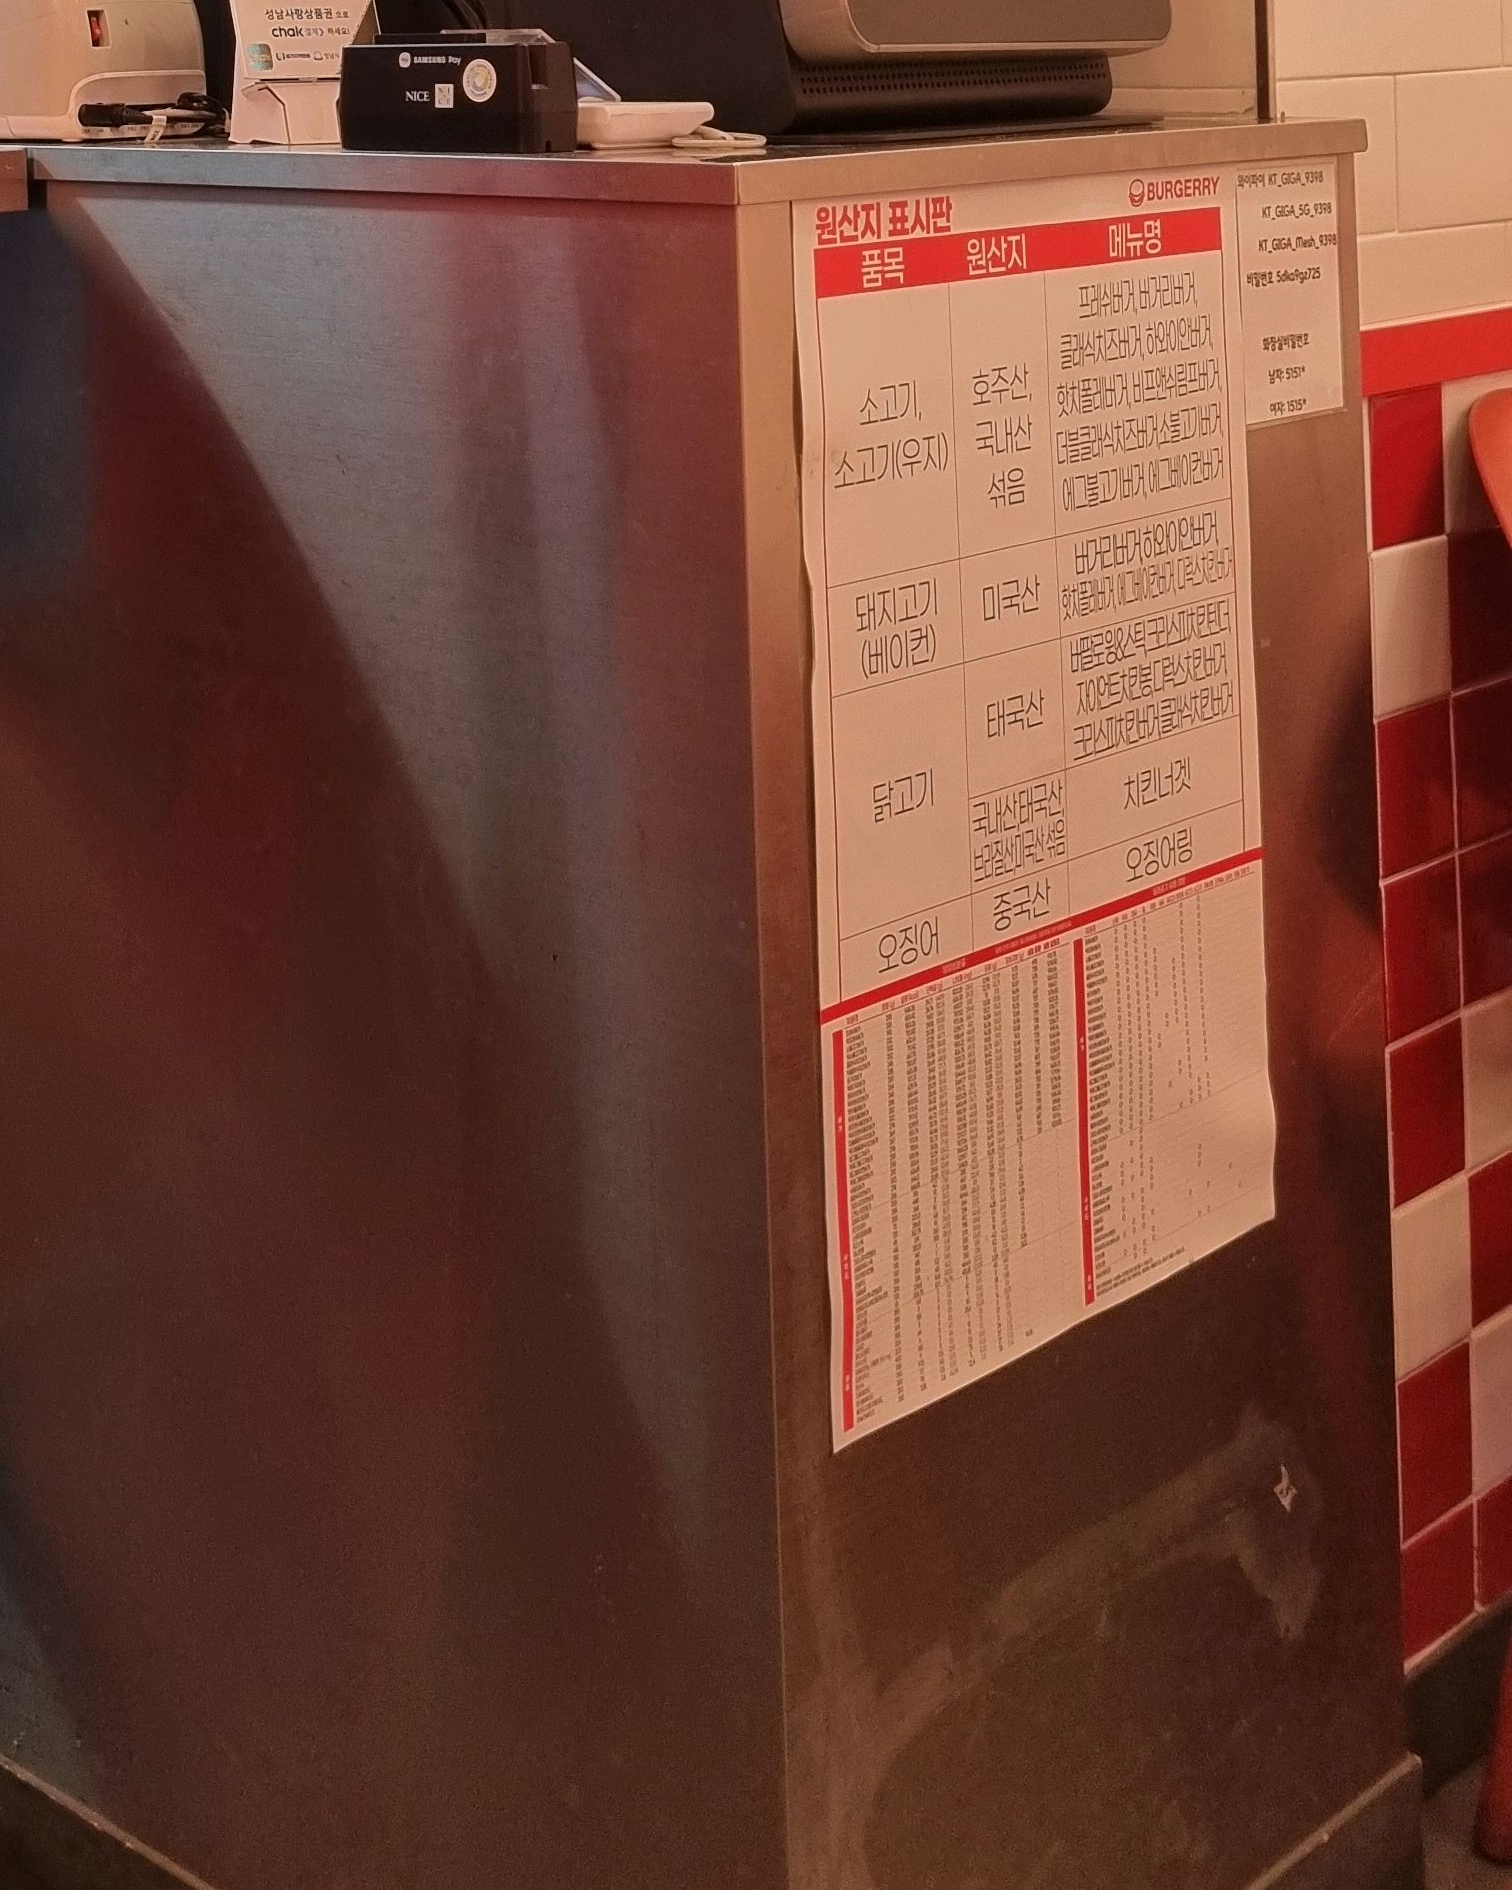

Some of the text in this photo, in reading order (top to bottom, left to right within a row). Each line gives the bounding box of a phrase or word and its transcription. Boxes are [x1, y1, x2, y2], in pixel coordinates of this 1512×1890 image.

[265, 8, 333, 21] 성남사랑상품권
[271, 25, 304, 38] chak
[448, 56, 461, 66] Pay
[405, 91, 430, 101] NICE
[1147, 176, 1220, 202] BURGERRY
[1268, 170, 1324, 187] KT_GIGA_9398
[816, 196, 952, 246] 원산지 표시판
[1262, 202, 1332, 220] KT_GIGA_5G_9398
[967, 233, 1027, 276] 원산지
[1108, 219, 1162, 258] 메뉴명
[1258, 233, 1337, 253] KT_GIGA_Mesh_9398
[861, 246, 905, 288] 품목
[1078, 271, 1198, 319] 프레쉬버거, 버거리버거,
[1060, 314, 1214, 370] 클래식치즈버거, 하와이안버거,
[859, 380, 922, 426] 소고기,
[972, 362, 1032, 406] 호주산,
[975, 413, 1032, 456] 국내산
[834, 431, 948, 489] 소고기(우지)
[987, 467, 1025, 509] 섞음
[855, 577, 938, 632] 돼지고기
[982, 574, 1040, 621] 미국산
[861, 623, 936, 679] (베이컨)
[986, 688, 1045, 738] 태국산
[872, 768, 935, 823] 닭고기
[1124, 756, 1191, 810] 치킨너겟
[1126, 826, 1193, 883] 오징어링
[993, 878, 1051, 932] 중국산
[878, 916, 939, 974] 오징어
